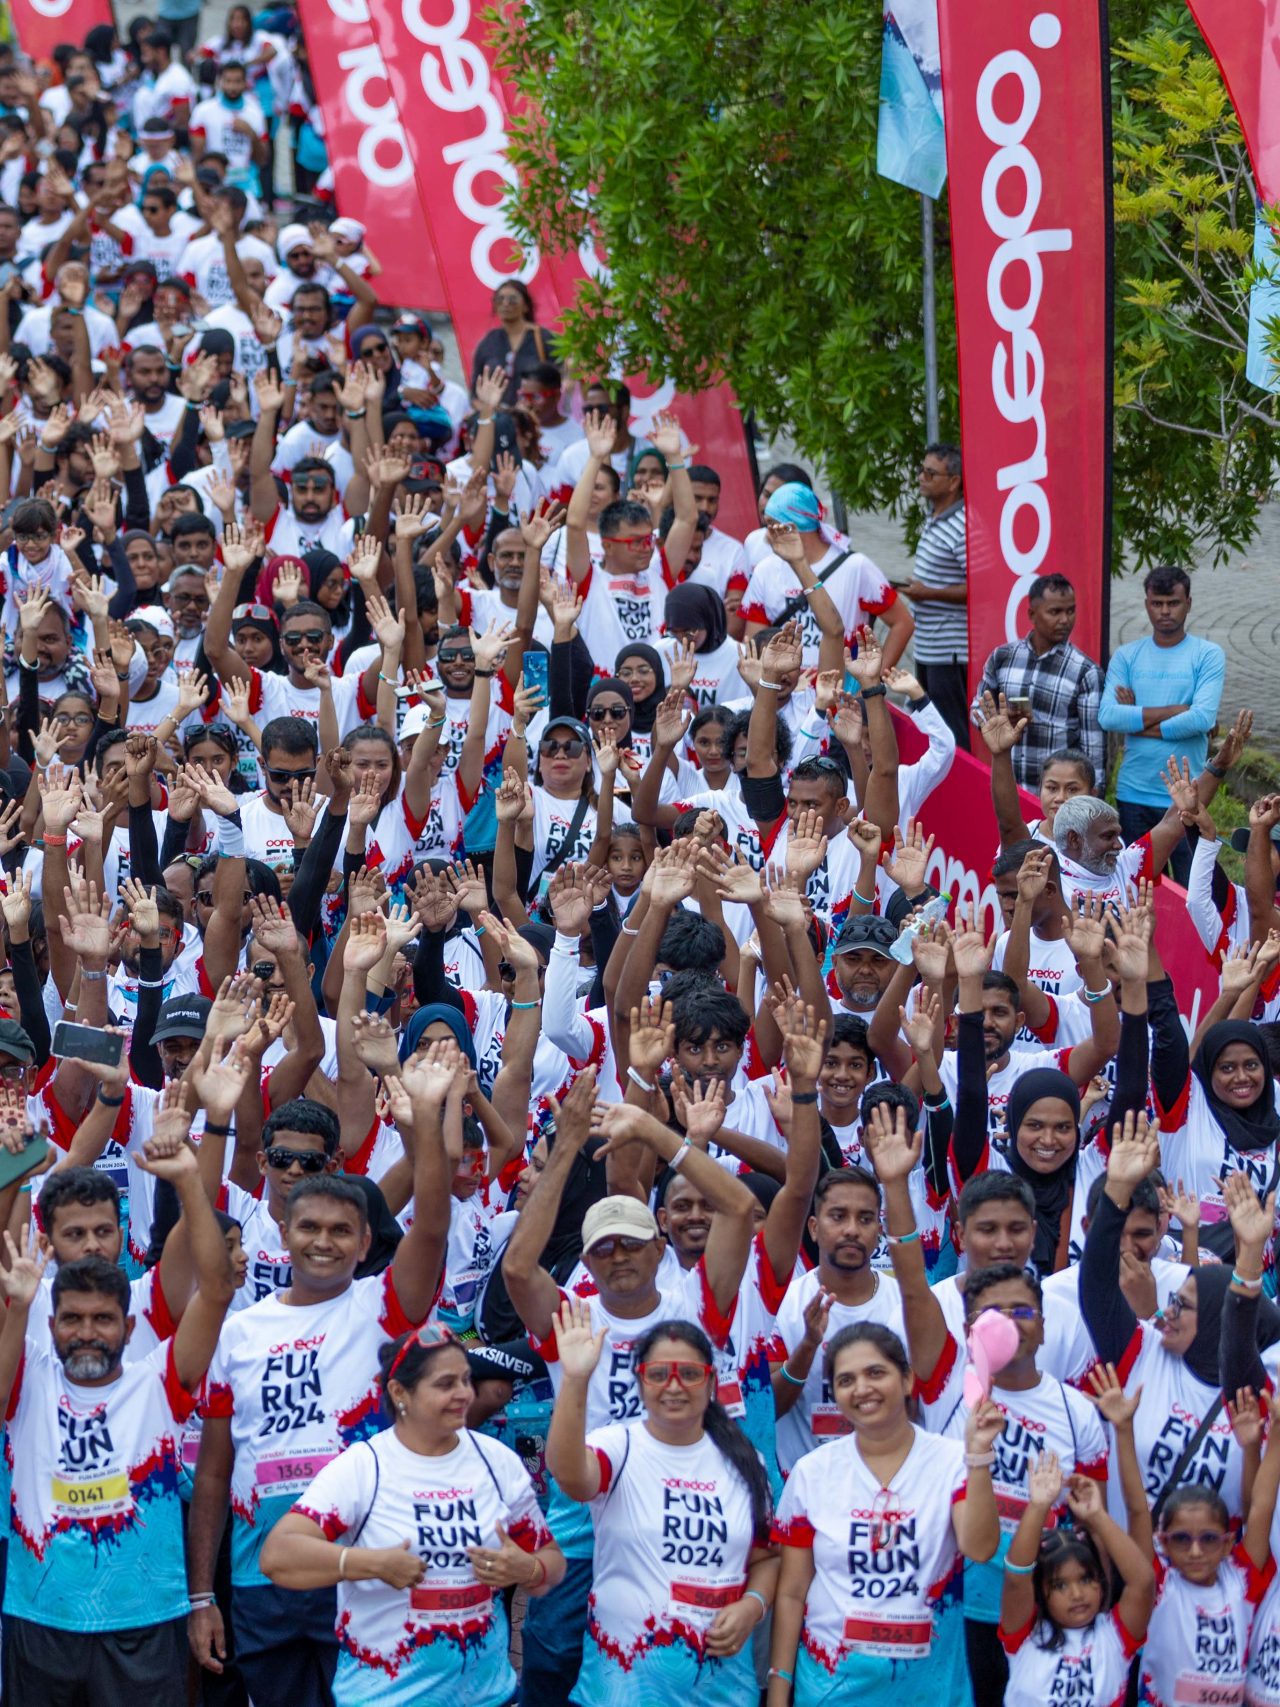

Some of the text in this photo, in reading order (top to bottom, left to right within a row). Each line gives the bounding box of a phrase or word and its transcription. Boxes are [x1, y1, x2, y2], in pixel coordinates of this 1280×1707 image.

[266, 840, 295, 848] oore
[254, 1262, 293, 1288] FU
[260, 1402, 325, 1437] 2024
[1003, 1420, 1044, 1454] UN
[277, 1463, 313, 1479] 1365
[68, 1486, 104, 1503] 0141
[664, 1488, 723, 1516] FUN
[413, 1499, 477, 1522] FUN
[418, 1526, 482, 1547] RUN
[663, 1515, 727, 1543] RUN
[849, 1518, 916, 1546] FUN
[662, 1542, 723, 1567] 2024
[848, 1544, 919, 1575] RUN
[852, 1576, 919, 1598] 2024
[1050, 1678, 1094, 1696] RUN
